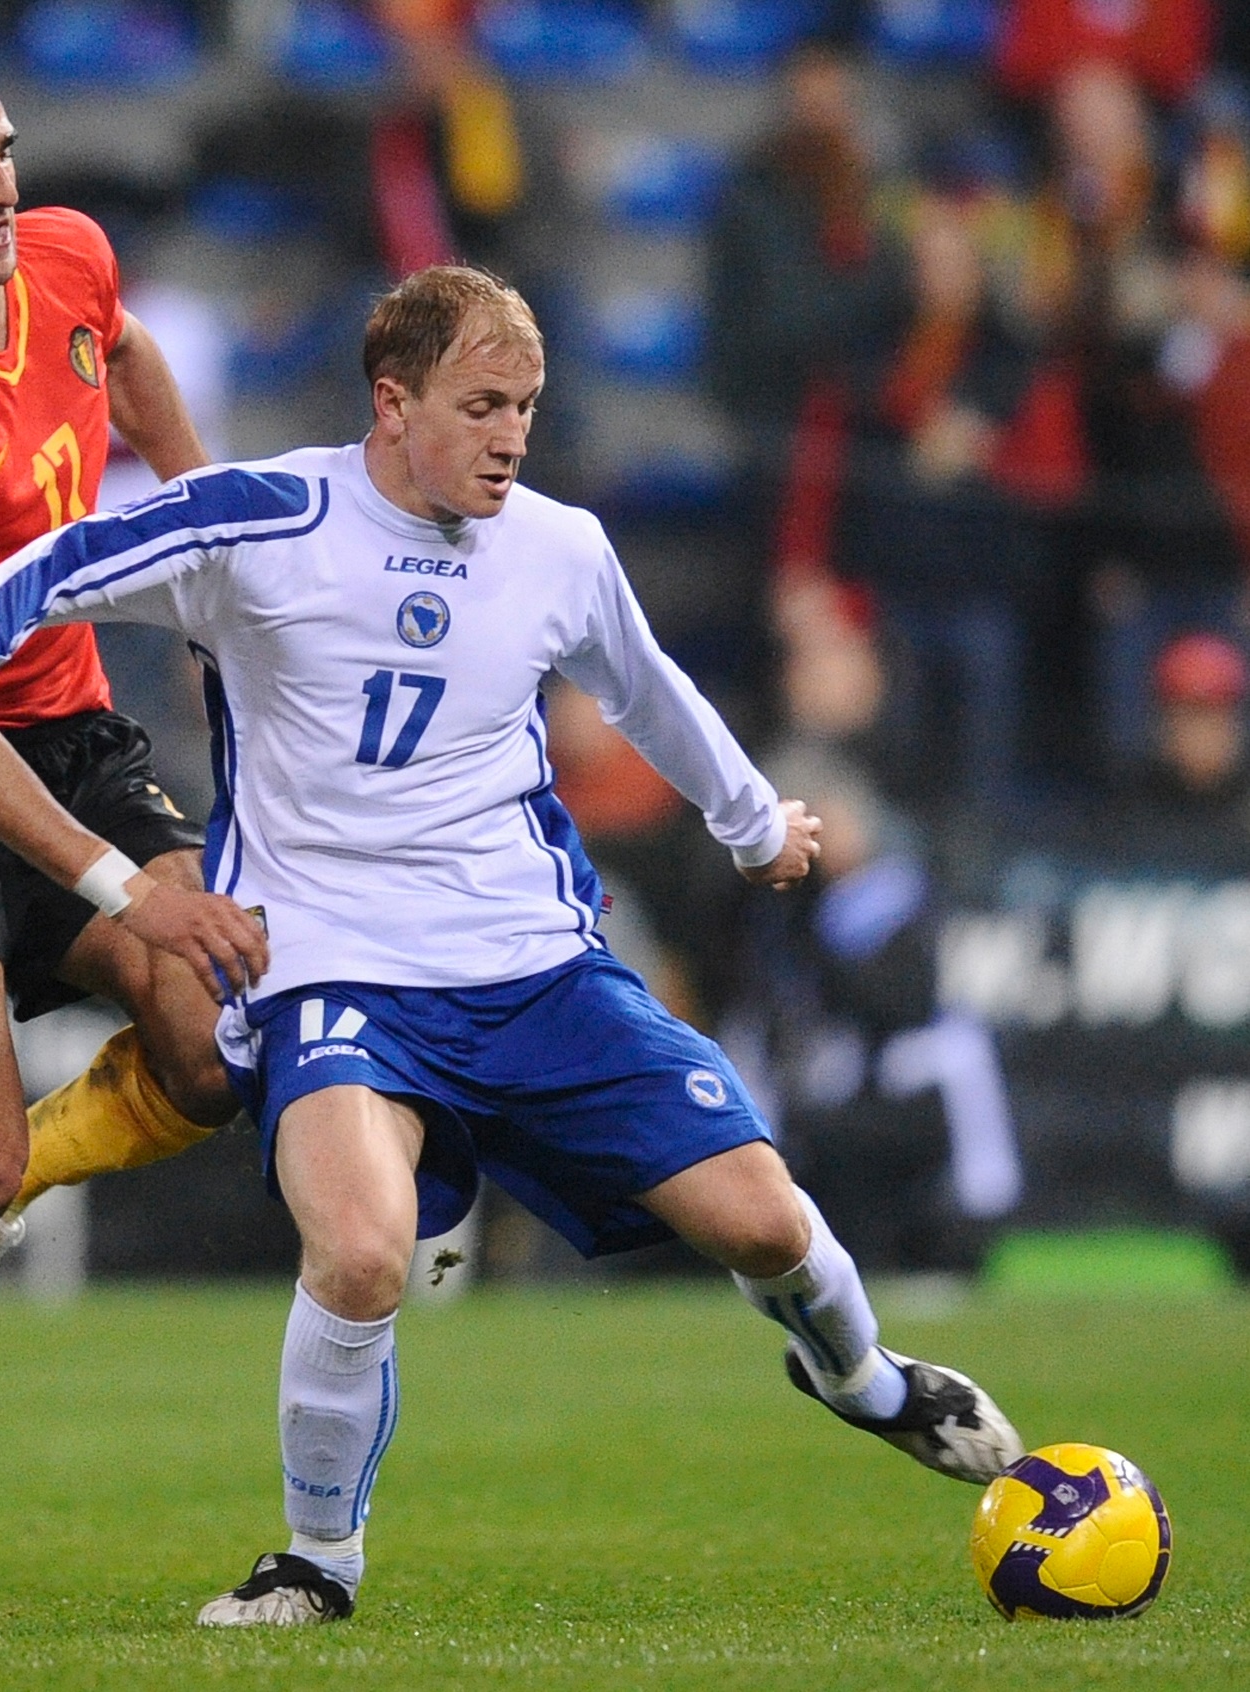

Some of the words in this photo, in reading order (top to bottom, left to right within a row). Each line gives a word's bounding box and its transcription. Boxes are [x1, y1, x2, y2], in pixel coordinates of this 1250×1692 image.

[32, 421, 88, 531] 17
[384, 555, 468, 580] LEGEA
[355, 669, 447, 768] 17
[297, 1044, 370, 1067] LEGEA
[286, 1471, 341, 1498] GEA
